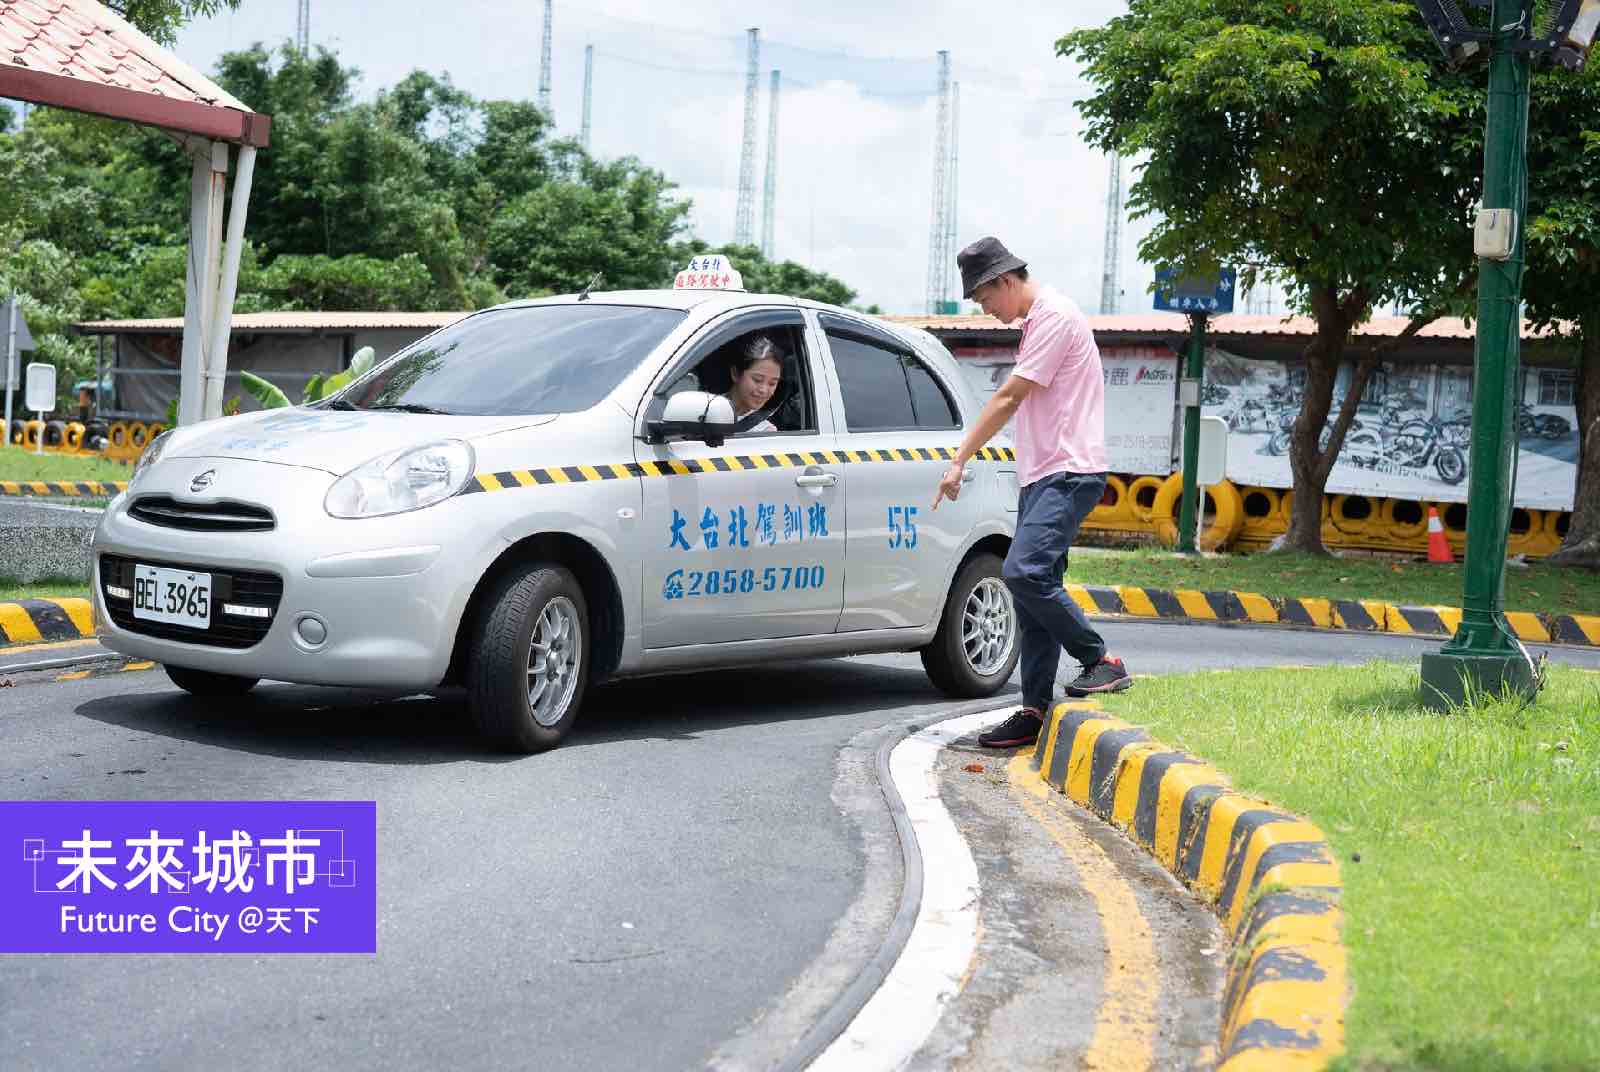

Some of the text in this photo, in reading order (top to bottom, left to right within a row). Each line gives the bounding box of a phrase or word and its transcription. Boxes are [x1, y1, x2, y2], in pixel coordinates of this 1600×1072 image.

[669, 502, 829, 551] 大台北駕訓班
[888, 506, 919, 549] 55
[687, 565, 825, 596] 2858-5700
